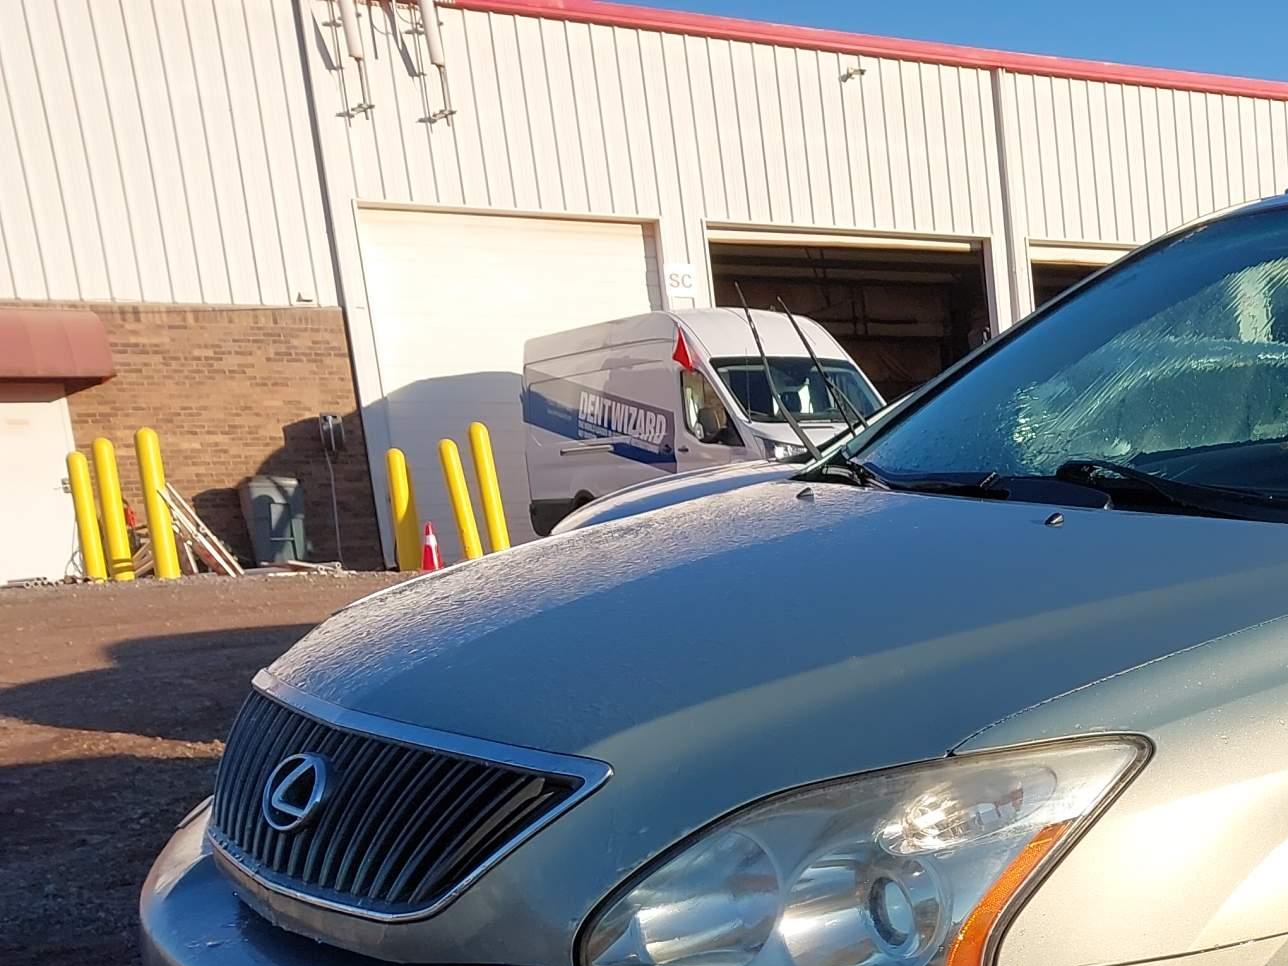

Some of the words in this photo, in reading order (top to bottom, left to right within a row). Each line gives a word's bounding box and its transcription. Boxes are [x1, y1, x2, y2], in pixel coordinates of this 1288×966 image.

[668, 273, 693, 289] SC
[578, 391, 612, 428] DENT
[610, 401, 667, 445] WIZARD
